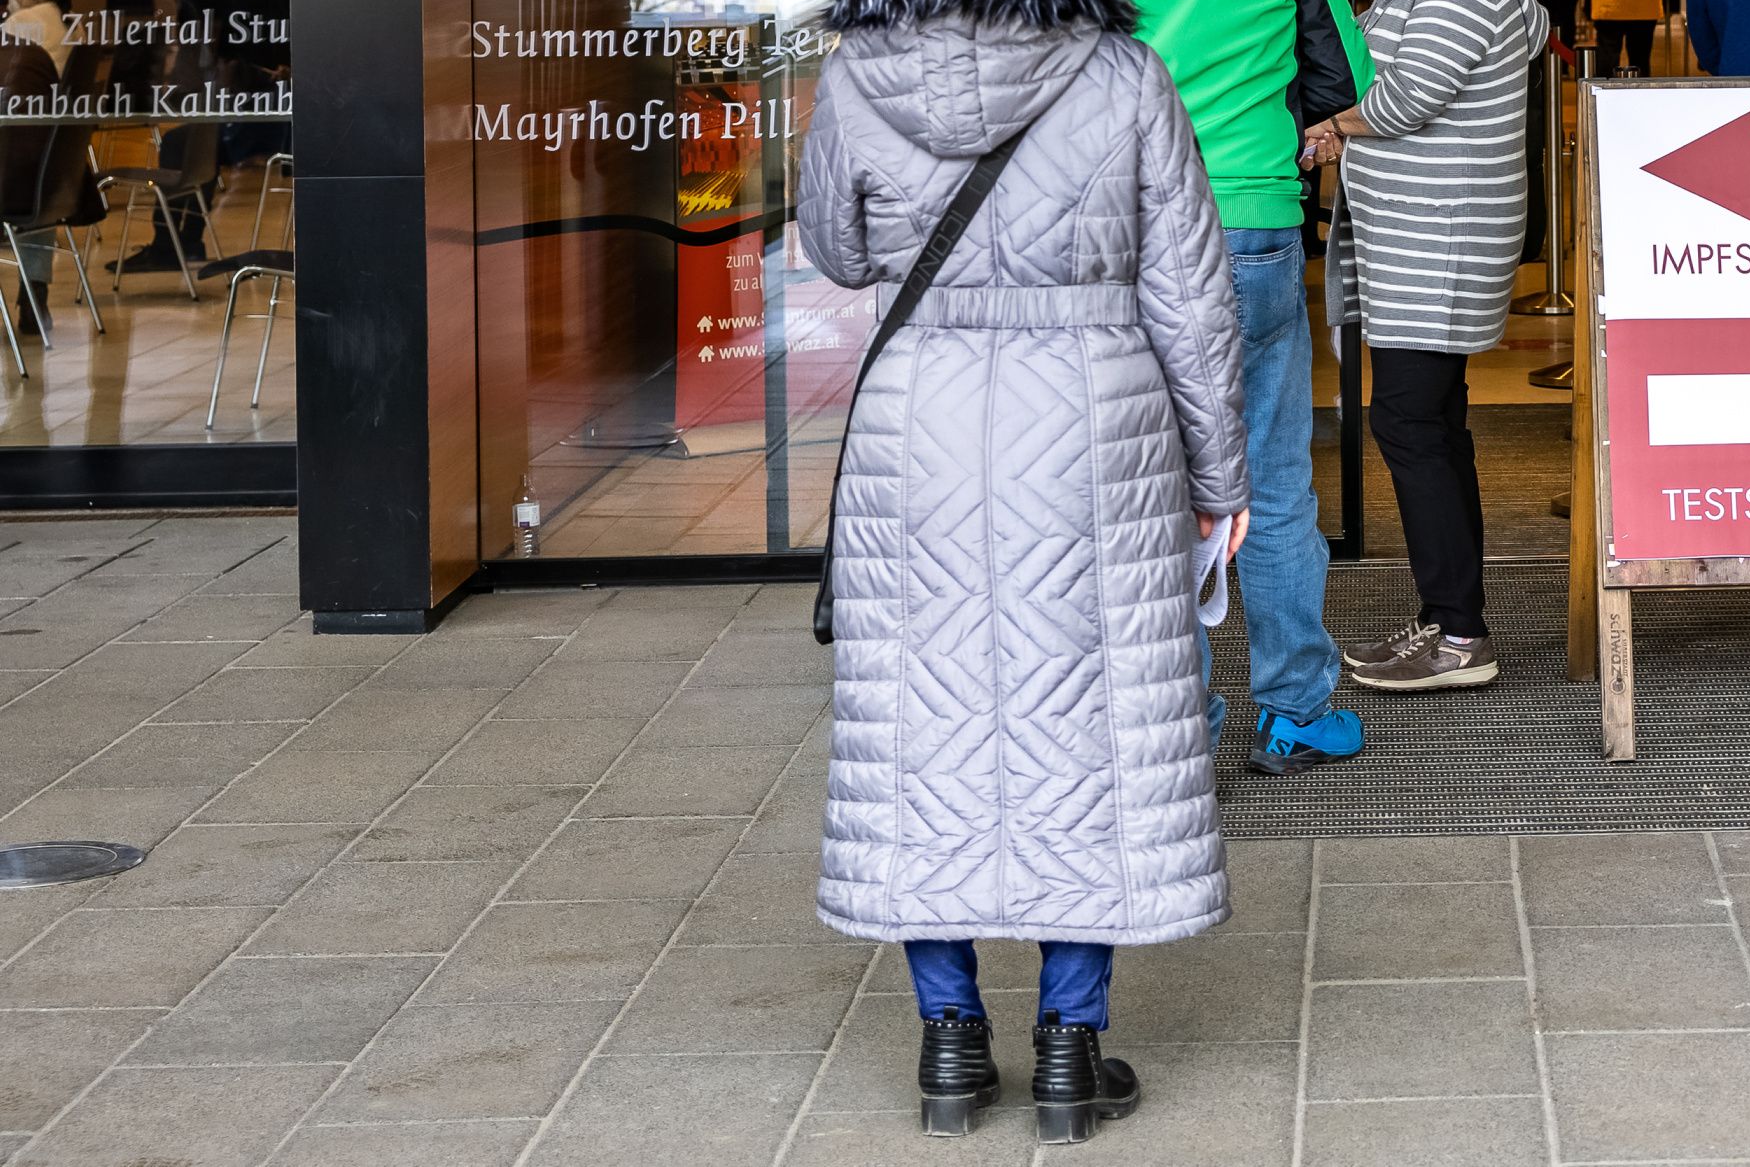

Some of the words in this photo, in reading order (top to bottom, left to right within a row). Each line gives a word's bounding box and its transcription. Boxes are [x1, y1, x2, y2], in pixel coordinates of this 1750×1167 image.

[61, 8, 213, 46] Zillertal
[473, 18, 747, 68] Stummerberg
[0, 82, 133, 119] enbach
[474, 99, 702, 152] Mayrhofen
[721, 98, 794, 140] Pill
[726, 253, 754, 269] zum
[734, 278, 749, 292] zu
[1610, 613, 1625, 676] schwaz
